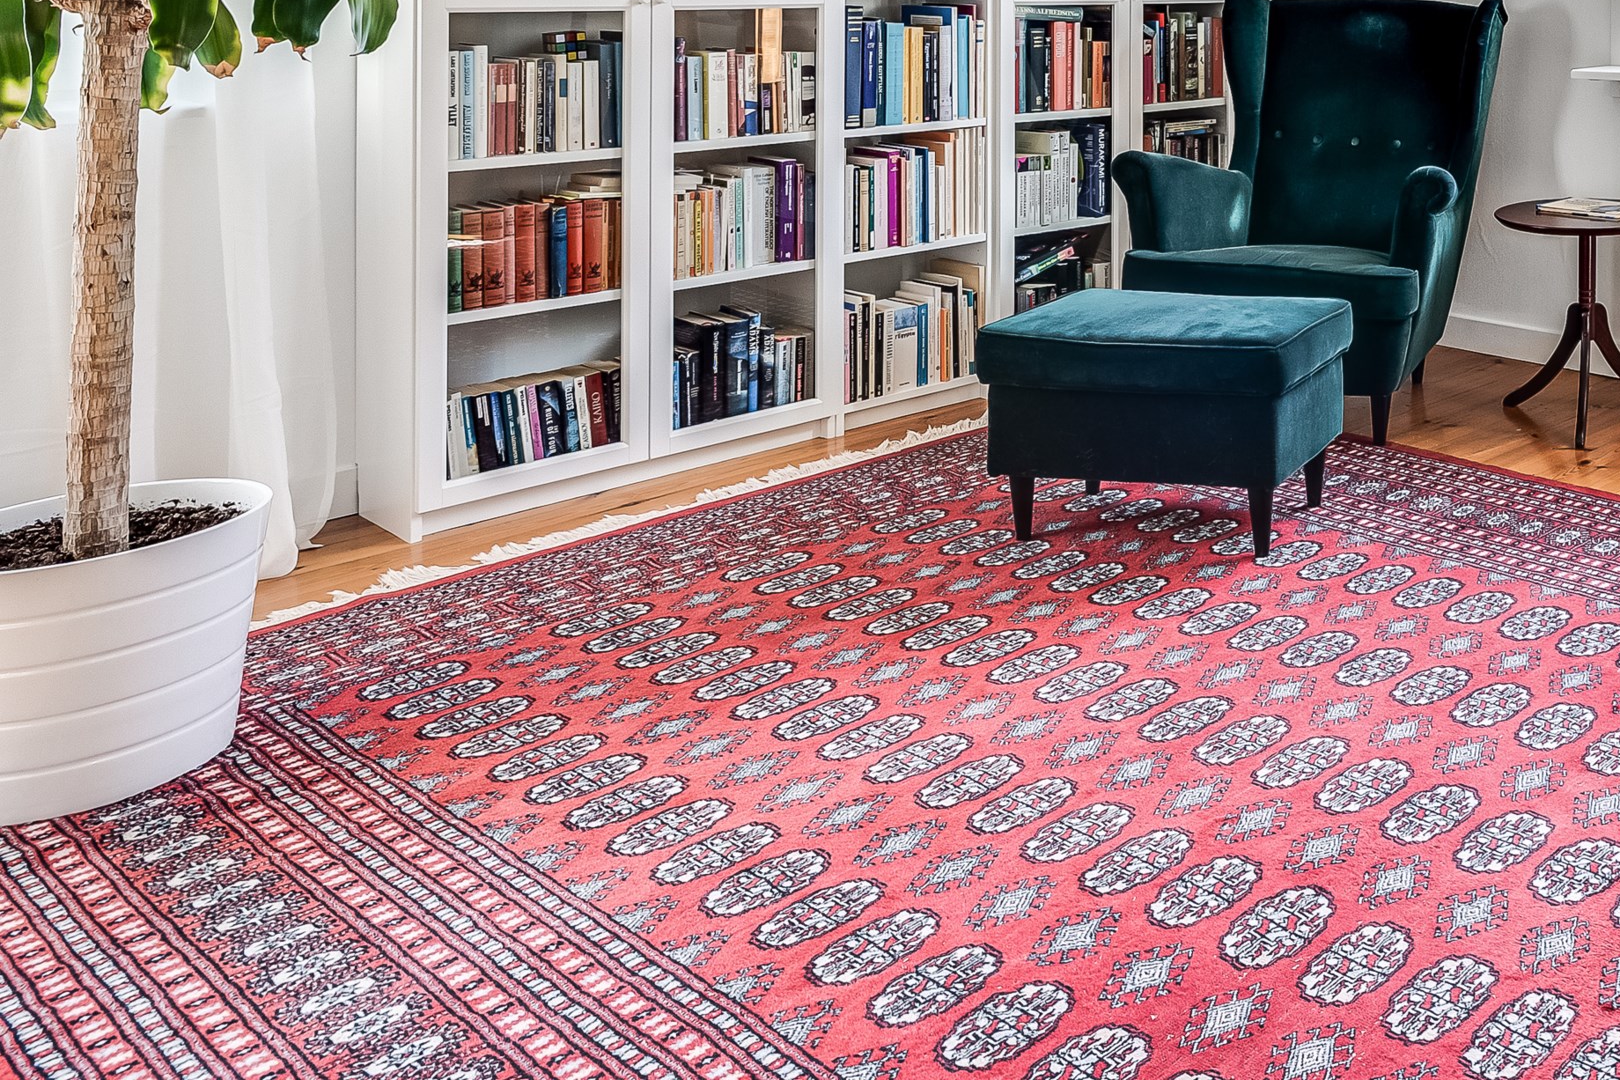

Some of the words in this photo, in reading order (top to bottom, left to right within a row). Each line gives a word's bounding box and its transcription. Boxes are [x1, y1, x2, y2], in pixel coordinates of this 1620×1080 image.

[448, 104, 457, 127] YLLET
[544, 408, 553, 424] RULE
[592, 392, 602, 424] KAIRO
[546, 426, 554, 435] OF
[548, 436, 557, 454] FOUR
